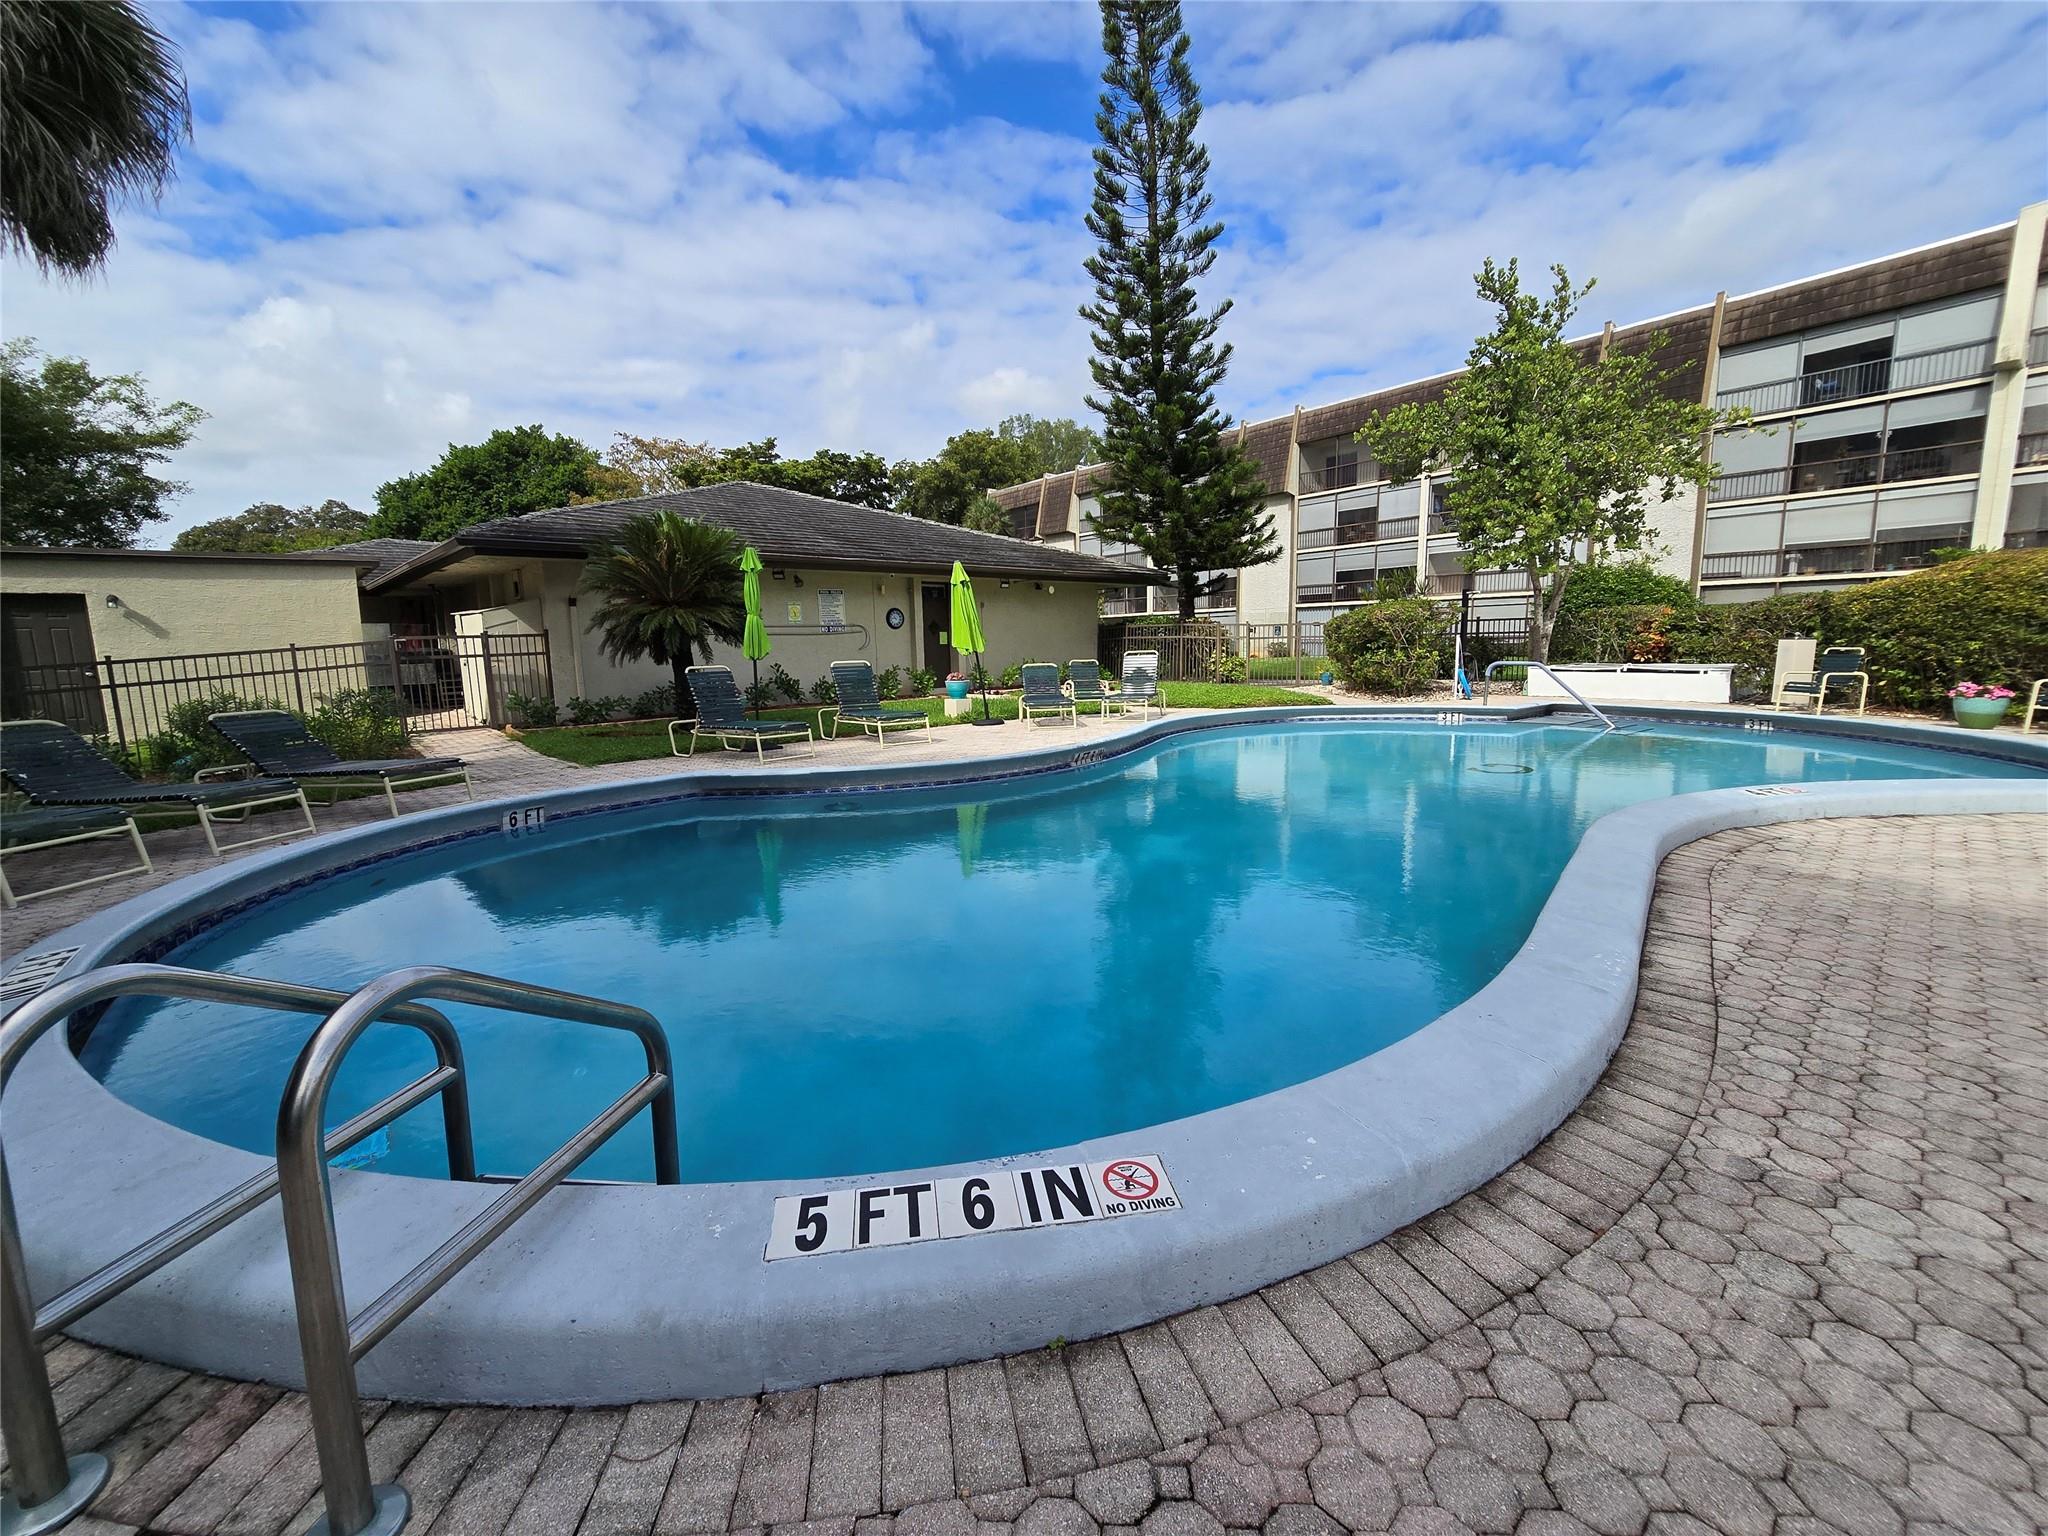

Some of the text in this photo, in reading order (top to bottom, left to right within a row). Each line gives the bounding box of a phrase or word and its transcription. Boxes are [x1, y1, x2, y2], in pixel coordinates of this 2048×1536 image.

[1442, 711, 1463, 721] 3 FT
[1749, 719, 1771, 730] 3 FT
[509, 806, 545, 828] 6 FT
[7, 955, 73, 978] FT
[794, 1166, 1095, 1252] 5 FT 6 IN
[1105, 1197, 1176, 1214] NO DIVING
